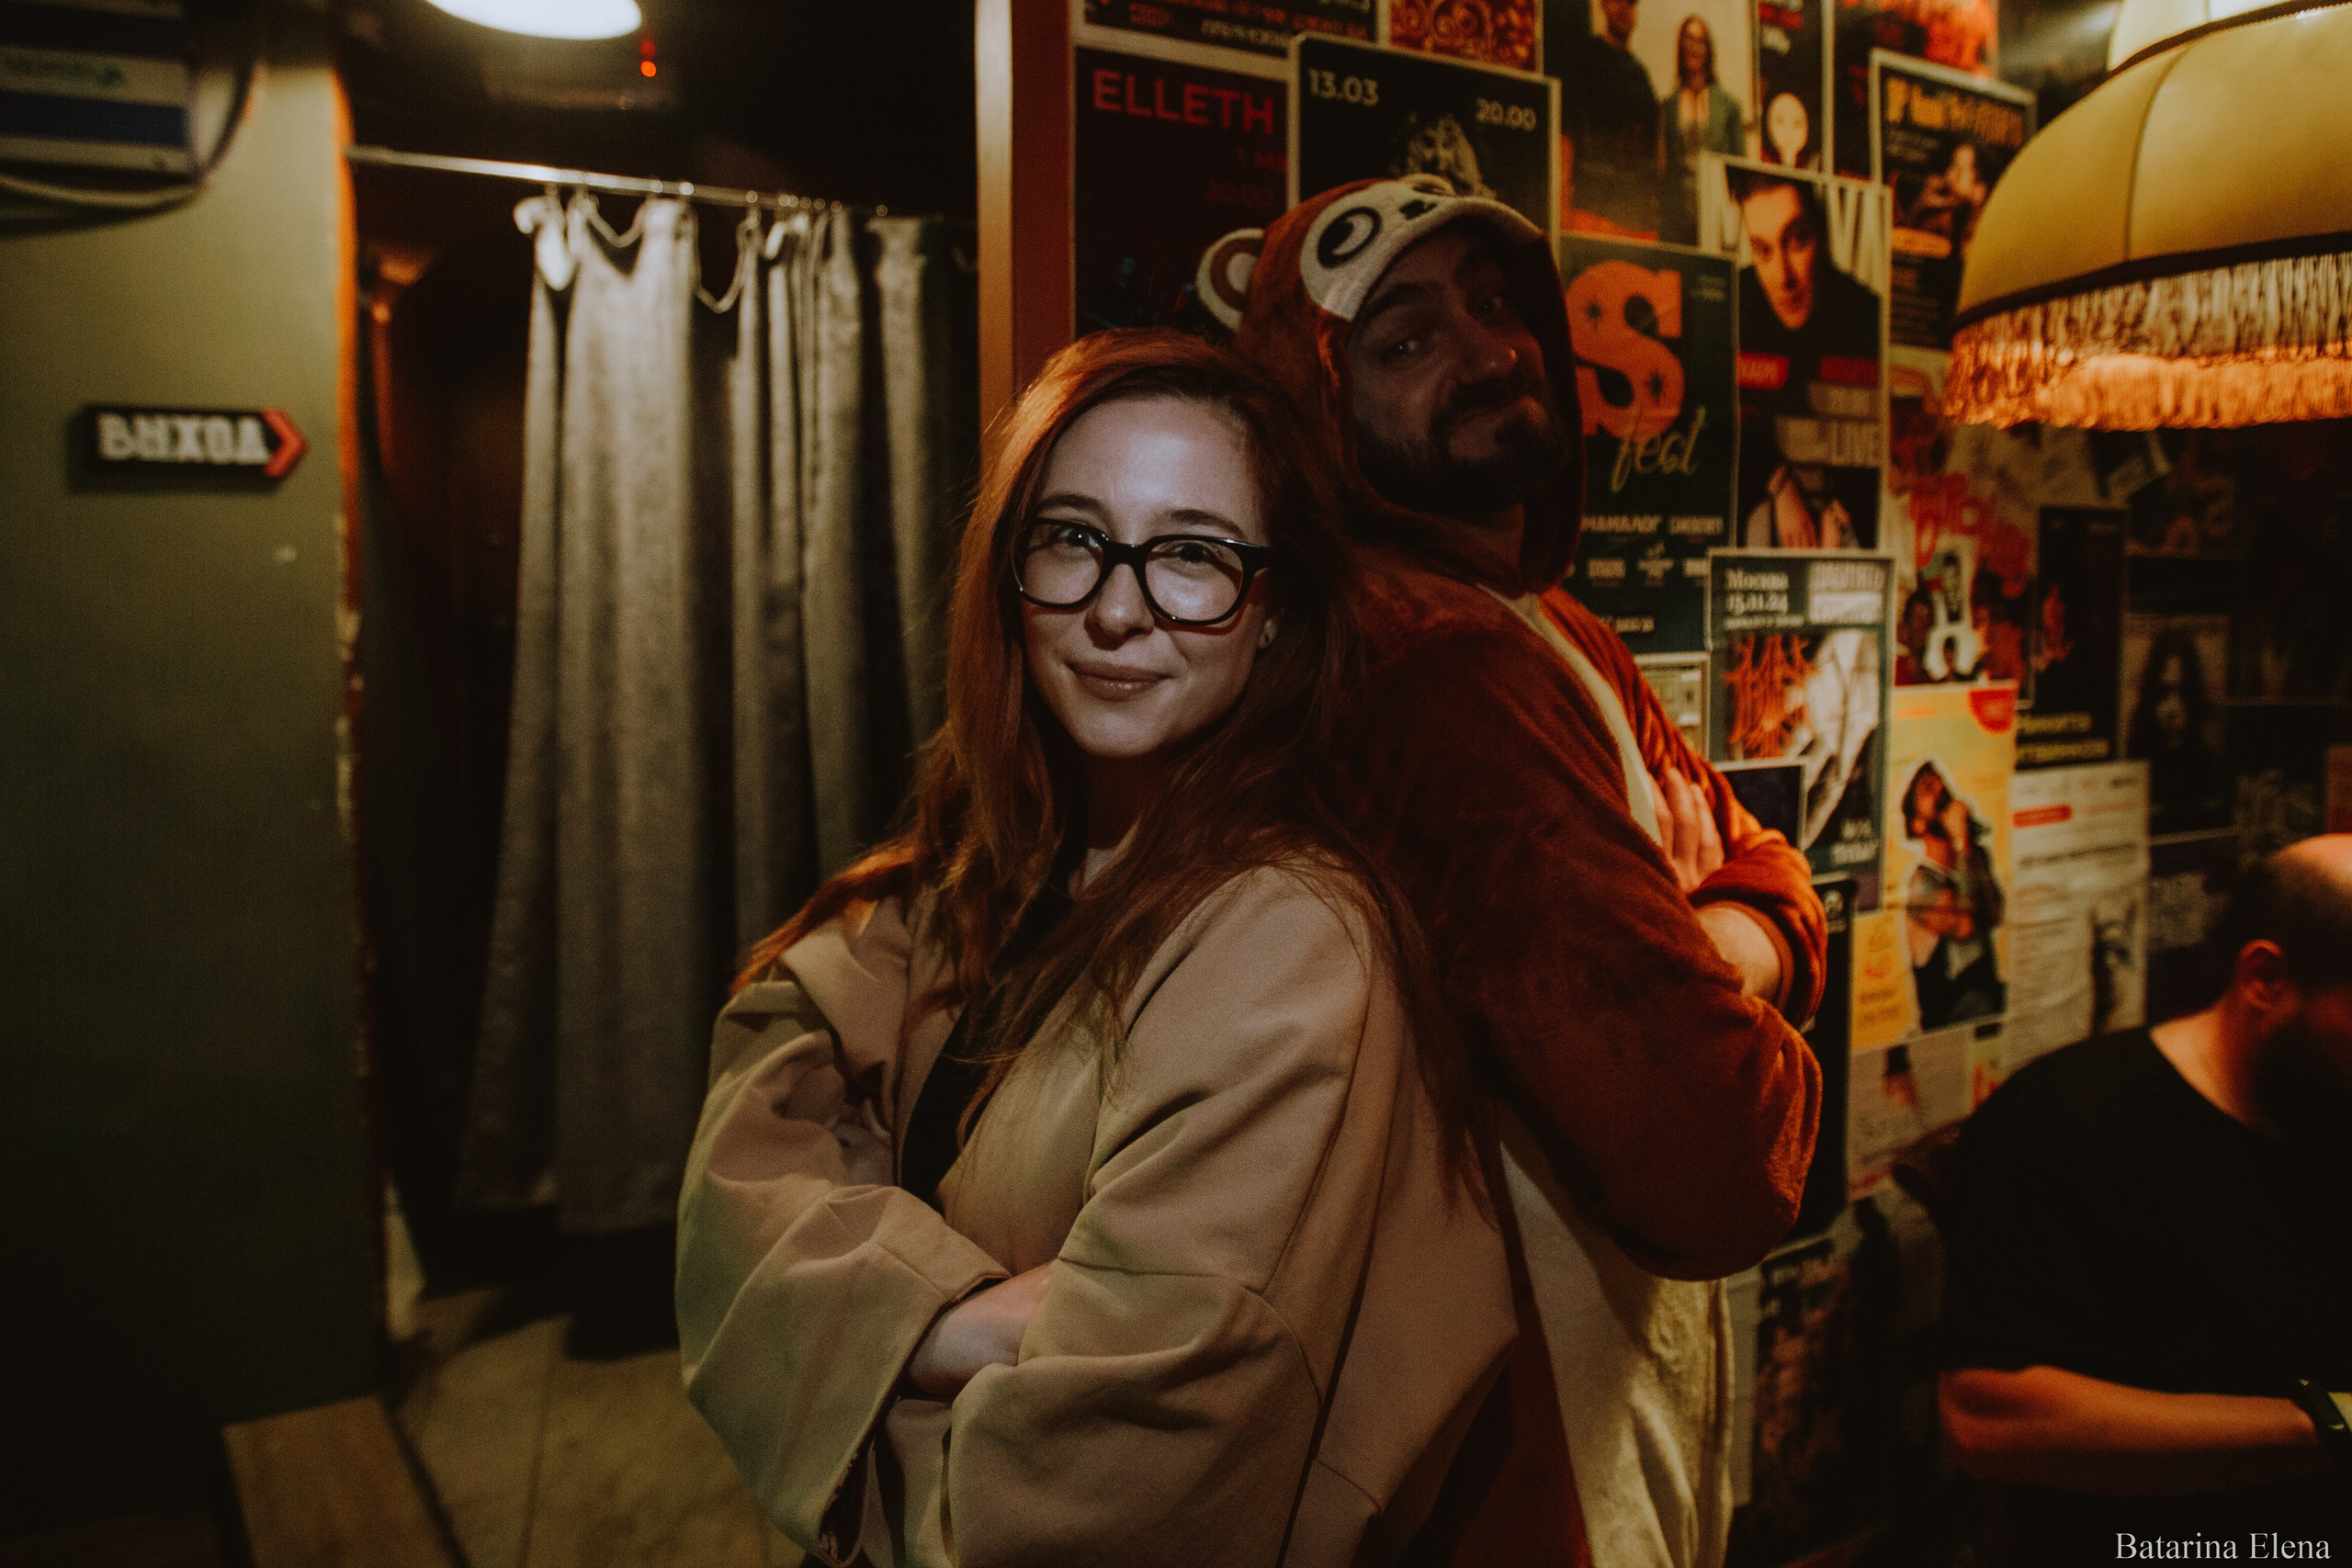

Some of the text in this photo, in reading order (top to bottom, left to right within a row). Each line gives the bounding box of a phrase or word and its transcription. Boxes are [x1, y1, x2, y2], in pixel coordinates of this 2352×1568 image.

[1091, 67, 1275, 136] ELLETH
[1307, 66, 1380, 107] 13.03
[97, 413, 271, 466] ВЫХОД
[1724, 567, 1790, 592] Москва
